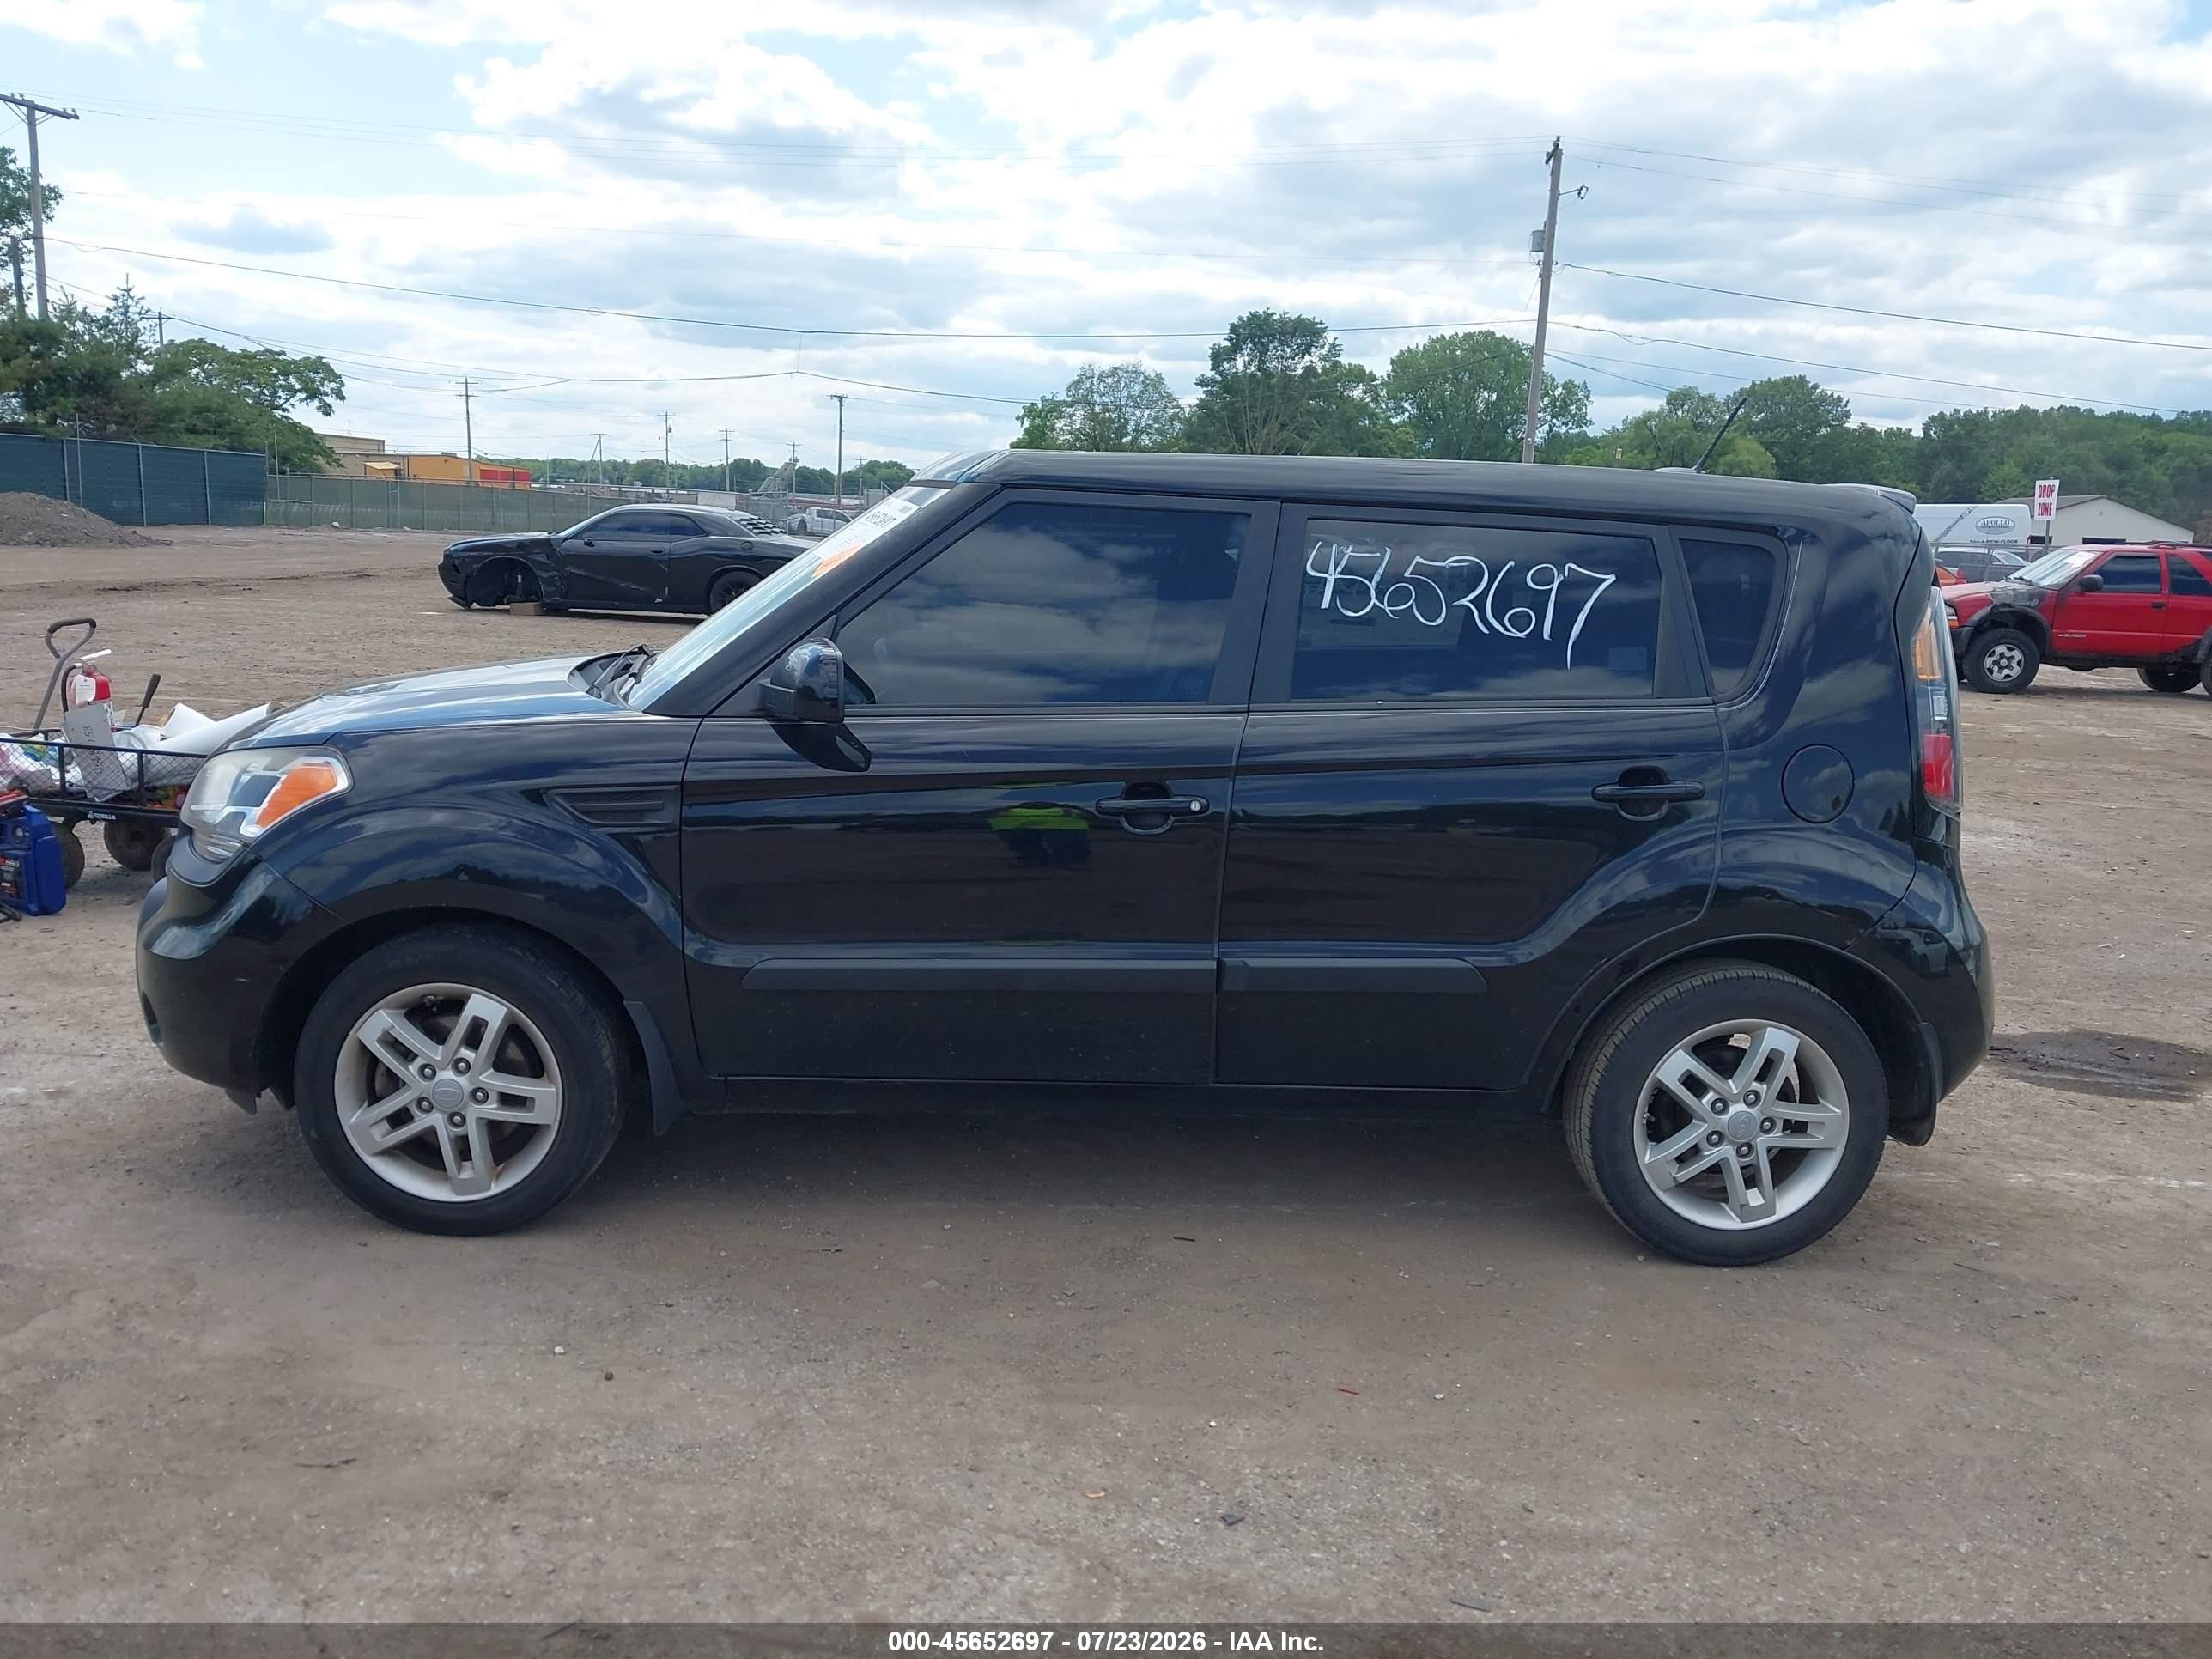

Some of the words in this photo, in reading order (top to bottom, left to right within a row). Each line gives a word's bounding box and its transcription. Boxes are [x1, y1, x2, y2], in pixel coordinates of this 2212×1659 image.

[2038, 484, 2056, 498] DROP
[2037, 501, 2053, 517] ZONE
[1305, 540, 1617, 672] 45652697
